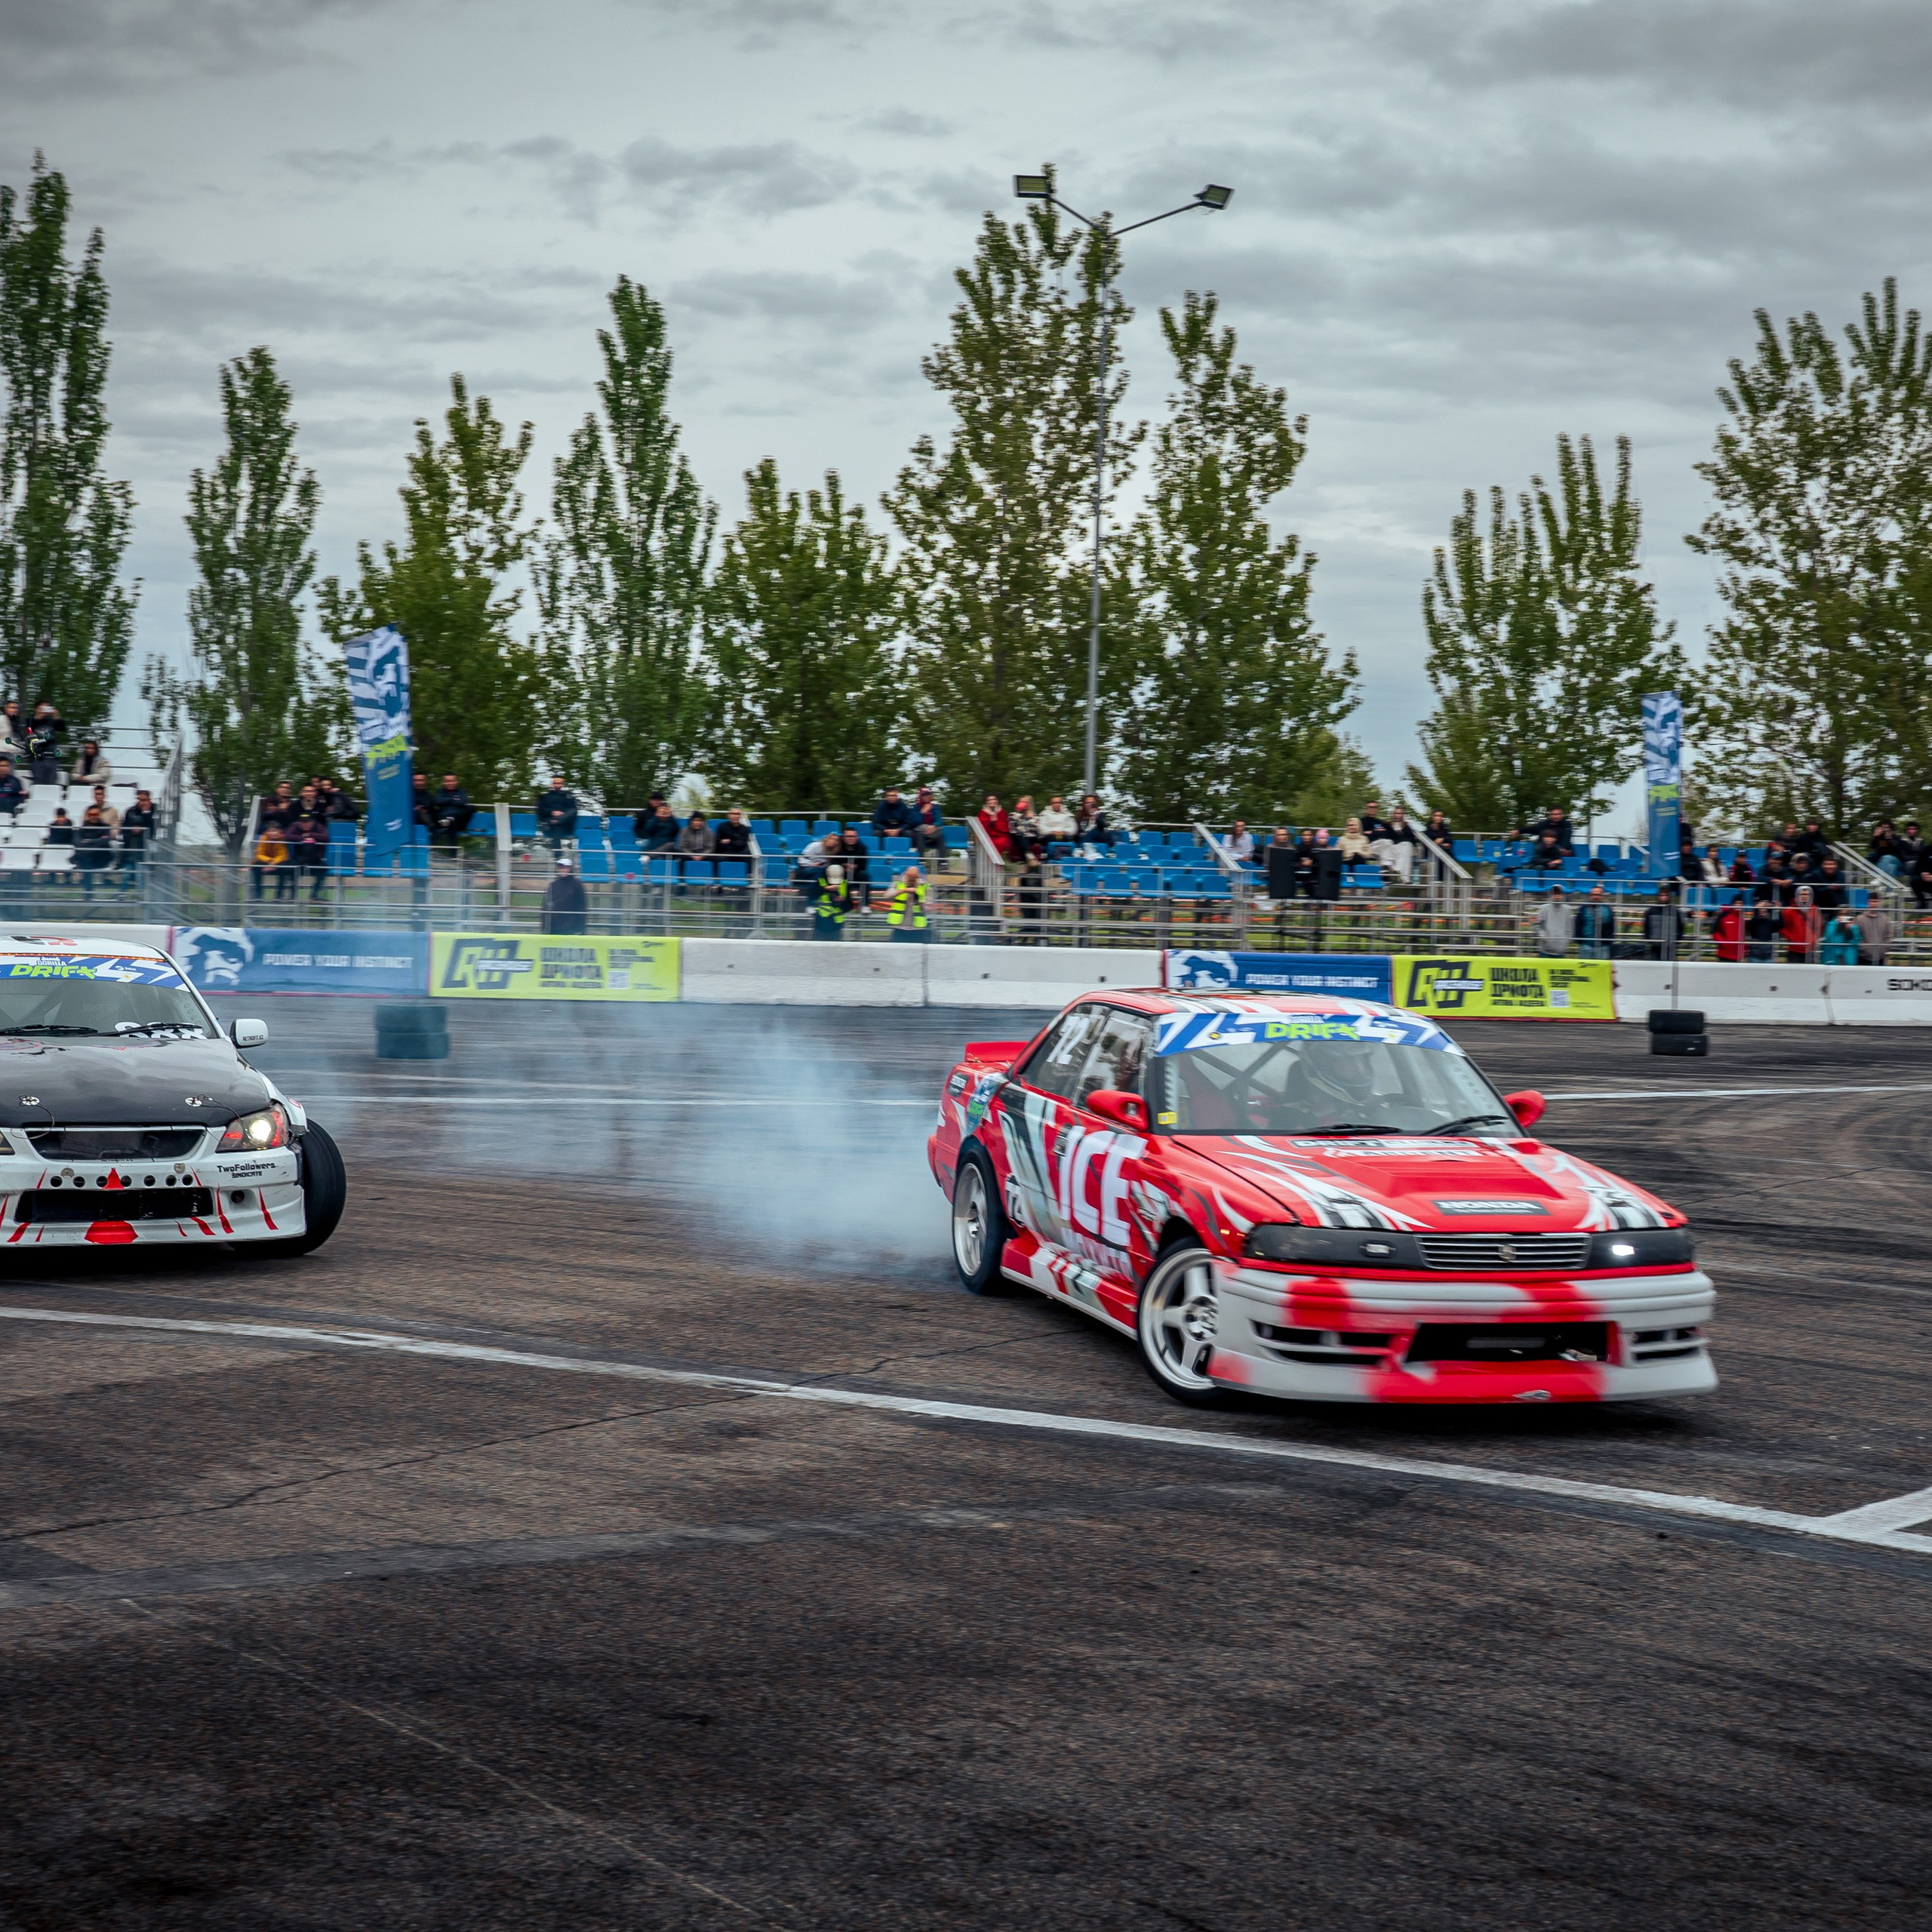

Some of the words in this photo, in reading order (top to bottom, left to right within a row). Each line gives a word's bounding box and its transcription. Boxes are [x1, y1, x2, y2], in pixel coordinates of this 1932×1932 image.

[314, 955, 351, 967] YOUR
[10, 964, 96, 980] DRIFT
[1291, 975, 1324, 986] YOUR
[1264, 1023, 1359, 1040] DRIFT
[217, 1163, 277, 1173] TwoFollowers
[1058, 1124, 1149, 1247] ICE
